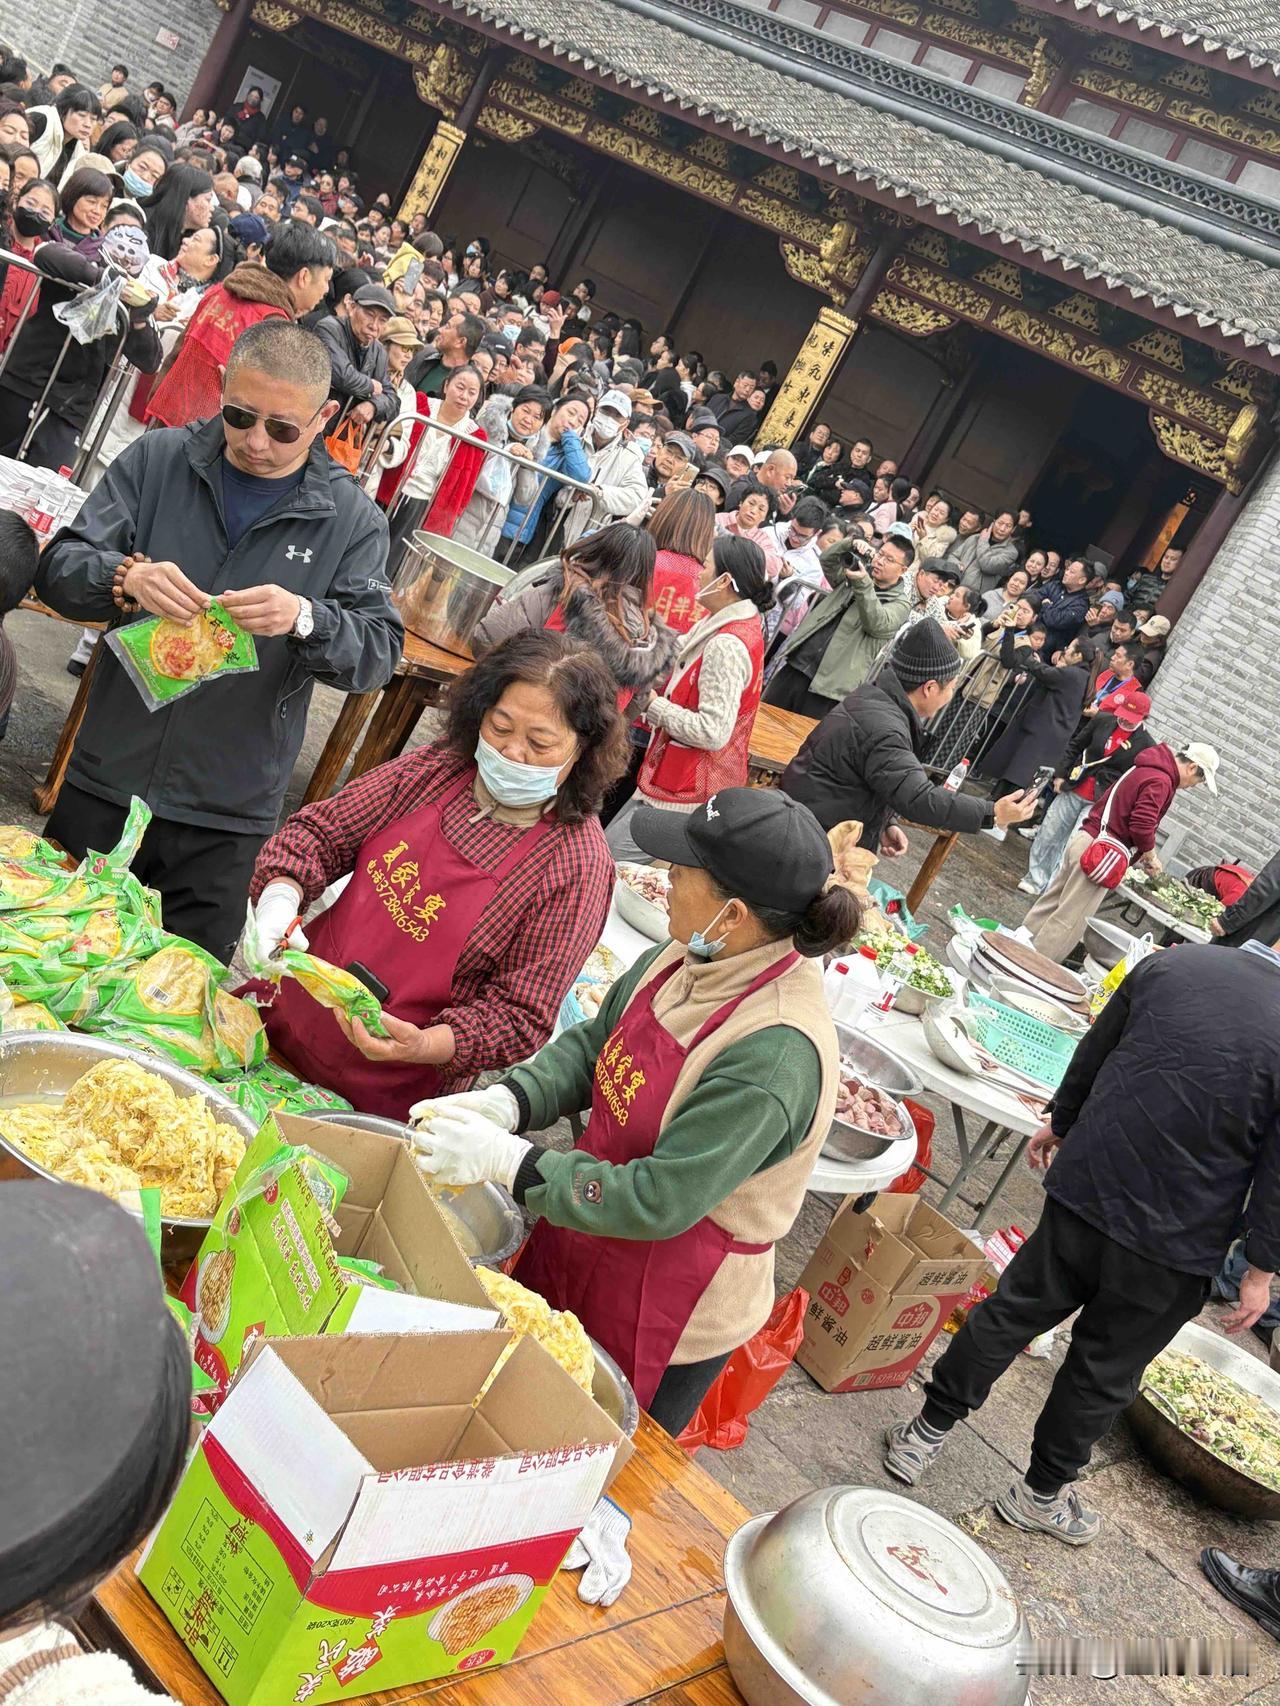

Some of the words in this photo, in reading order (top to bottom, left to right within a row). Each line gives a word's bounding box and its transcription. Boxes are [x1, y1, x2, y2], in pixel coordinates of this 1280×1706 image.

[919, 1270, 969, 1286] 超鲜酱油
[807, 1295, 849, 1347] 鲜酱油
[866, 1333, 923, 1352] 超鲜酱油
